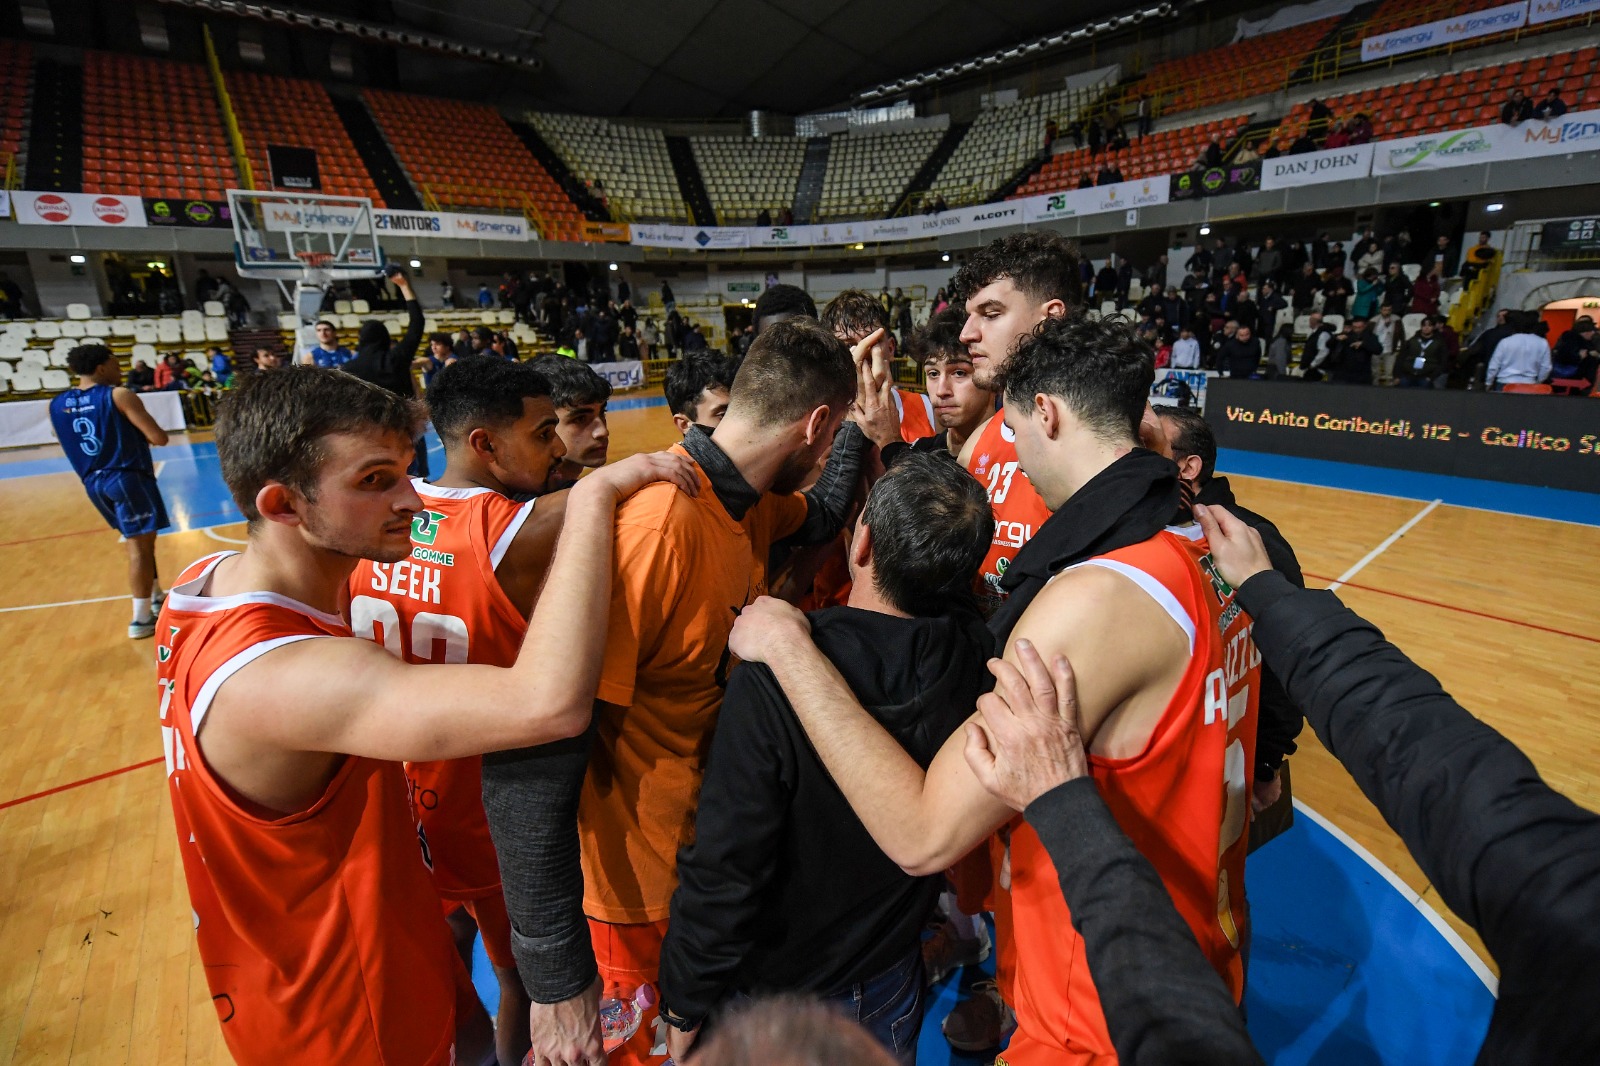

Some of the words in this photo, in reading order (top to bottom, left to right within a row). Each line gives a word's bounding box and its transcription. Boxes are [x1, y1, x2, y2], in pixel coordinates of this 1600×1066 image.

[1524, 121, 1600, 144] MyEn
[1275, 160, 1308, 176] DAN
[1311, 153, 1358, 174] JOHN
[374, 214, 441, 232] 2FMOTORS
[922, 219, 939, 230] DAN
[939, 215, 961, 229] JOHN
[973, 208, 1017, 222] ALCOTT
[72, 416, 101, 456] 3
[1226, 405, 1255, 424] Via
[1257, 408, 1309, 428] Anita
[1314, 413, 1415, 440] Garibaldi,
[1422, 423, 1452, 441] 112
[1481, 426, 1570, 452] Gallico
[987, 461, 1019, 504] 23
[412, 547, 455, 567] GOMME
